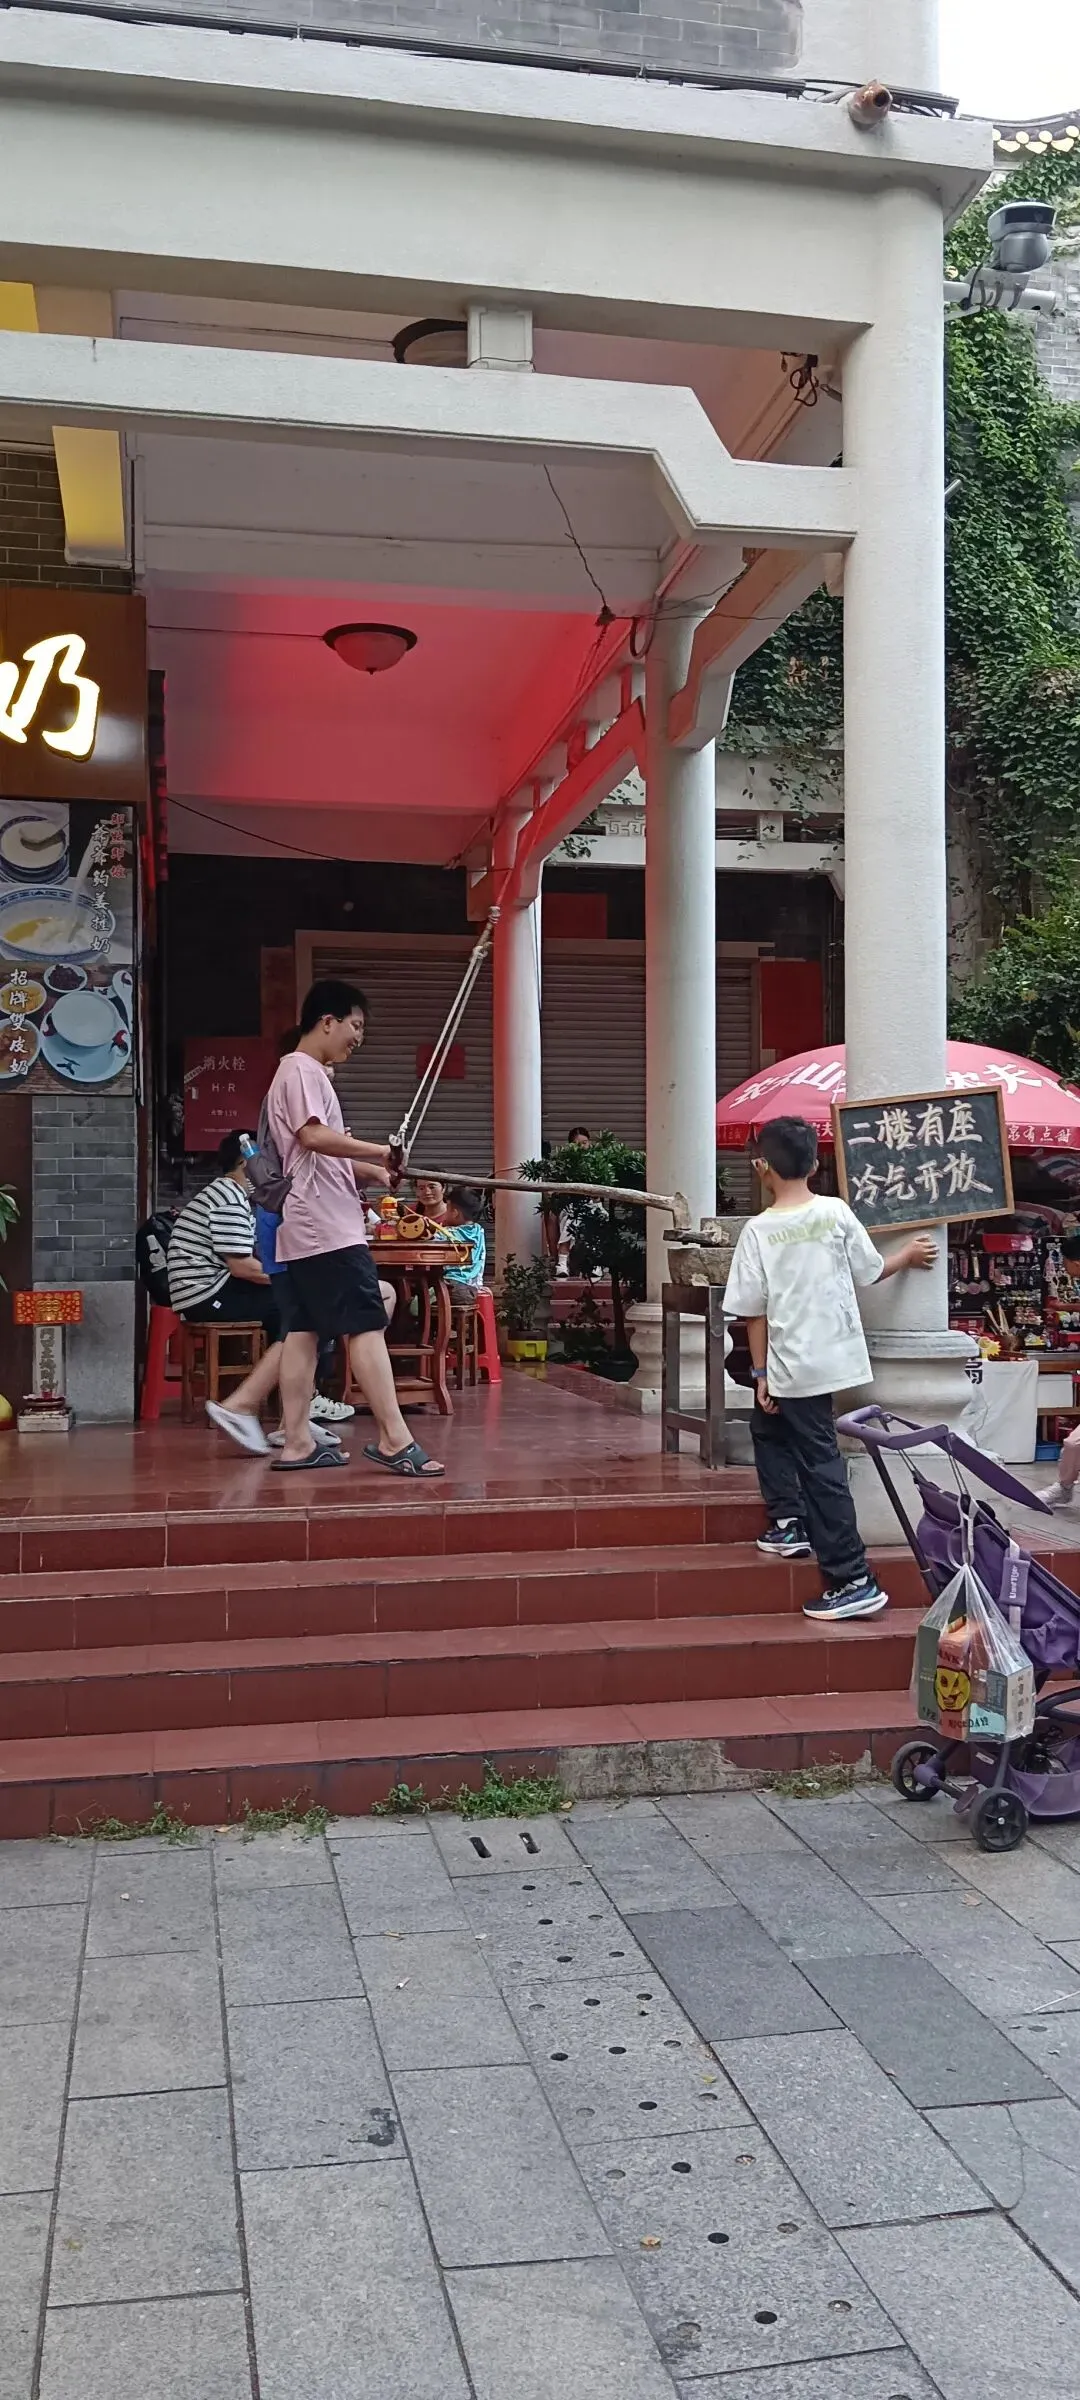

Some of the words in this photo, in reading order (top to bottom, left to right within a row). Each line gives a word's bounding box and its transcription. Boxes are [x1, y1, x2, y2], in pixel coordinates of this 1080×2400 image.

[0, 634, 100, 758] 奶
[203, 1056, 246, 1071] 消火栓
[728, 1061, 846, 1110] 农夫山
[847, 1100, 983, 1151] 二楼有座
[850, 1150, 994, 1208] 冷气开放
